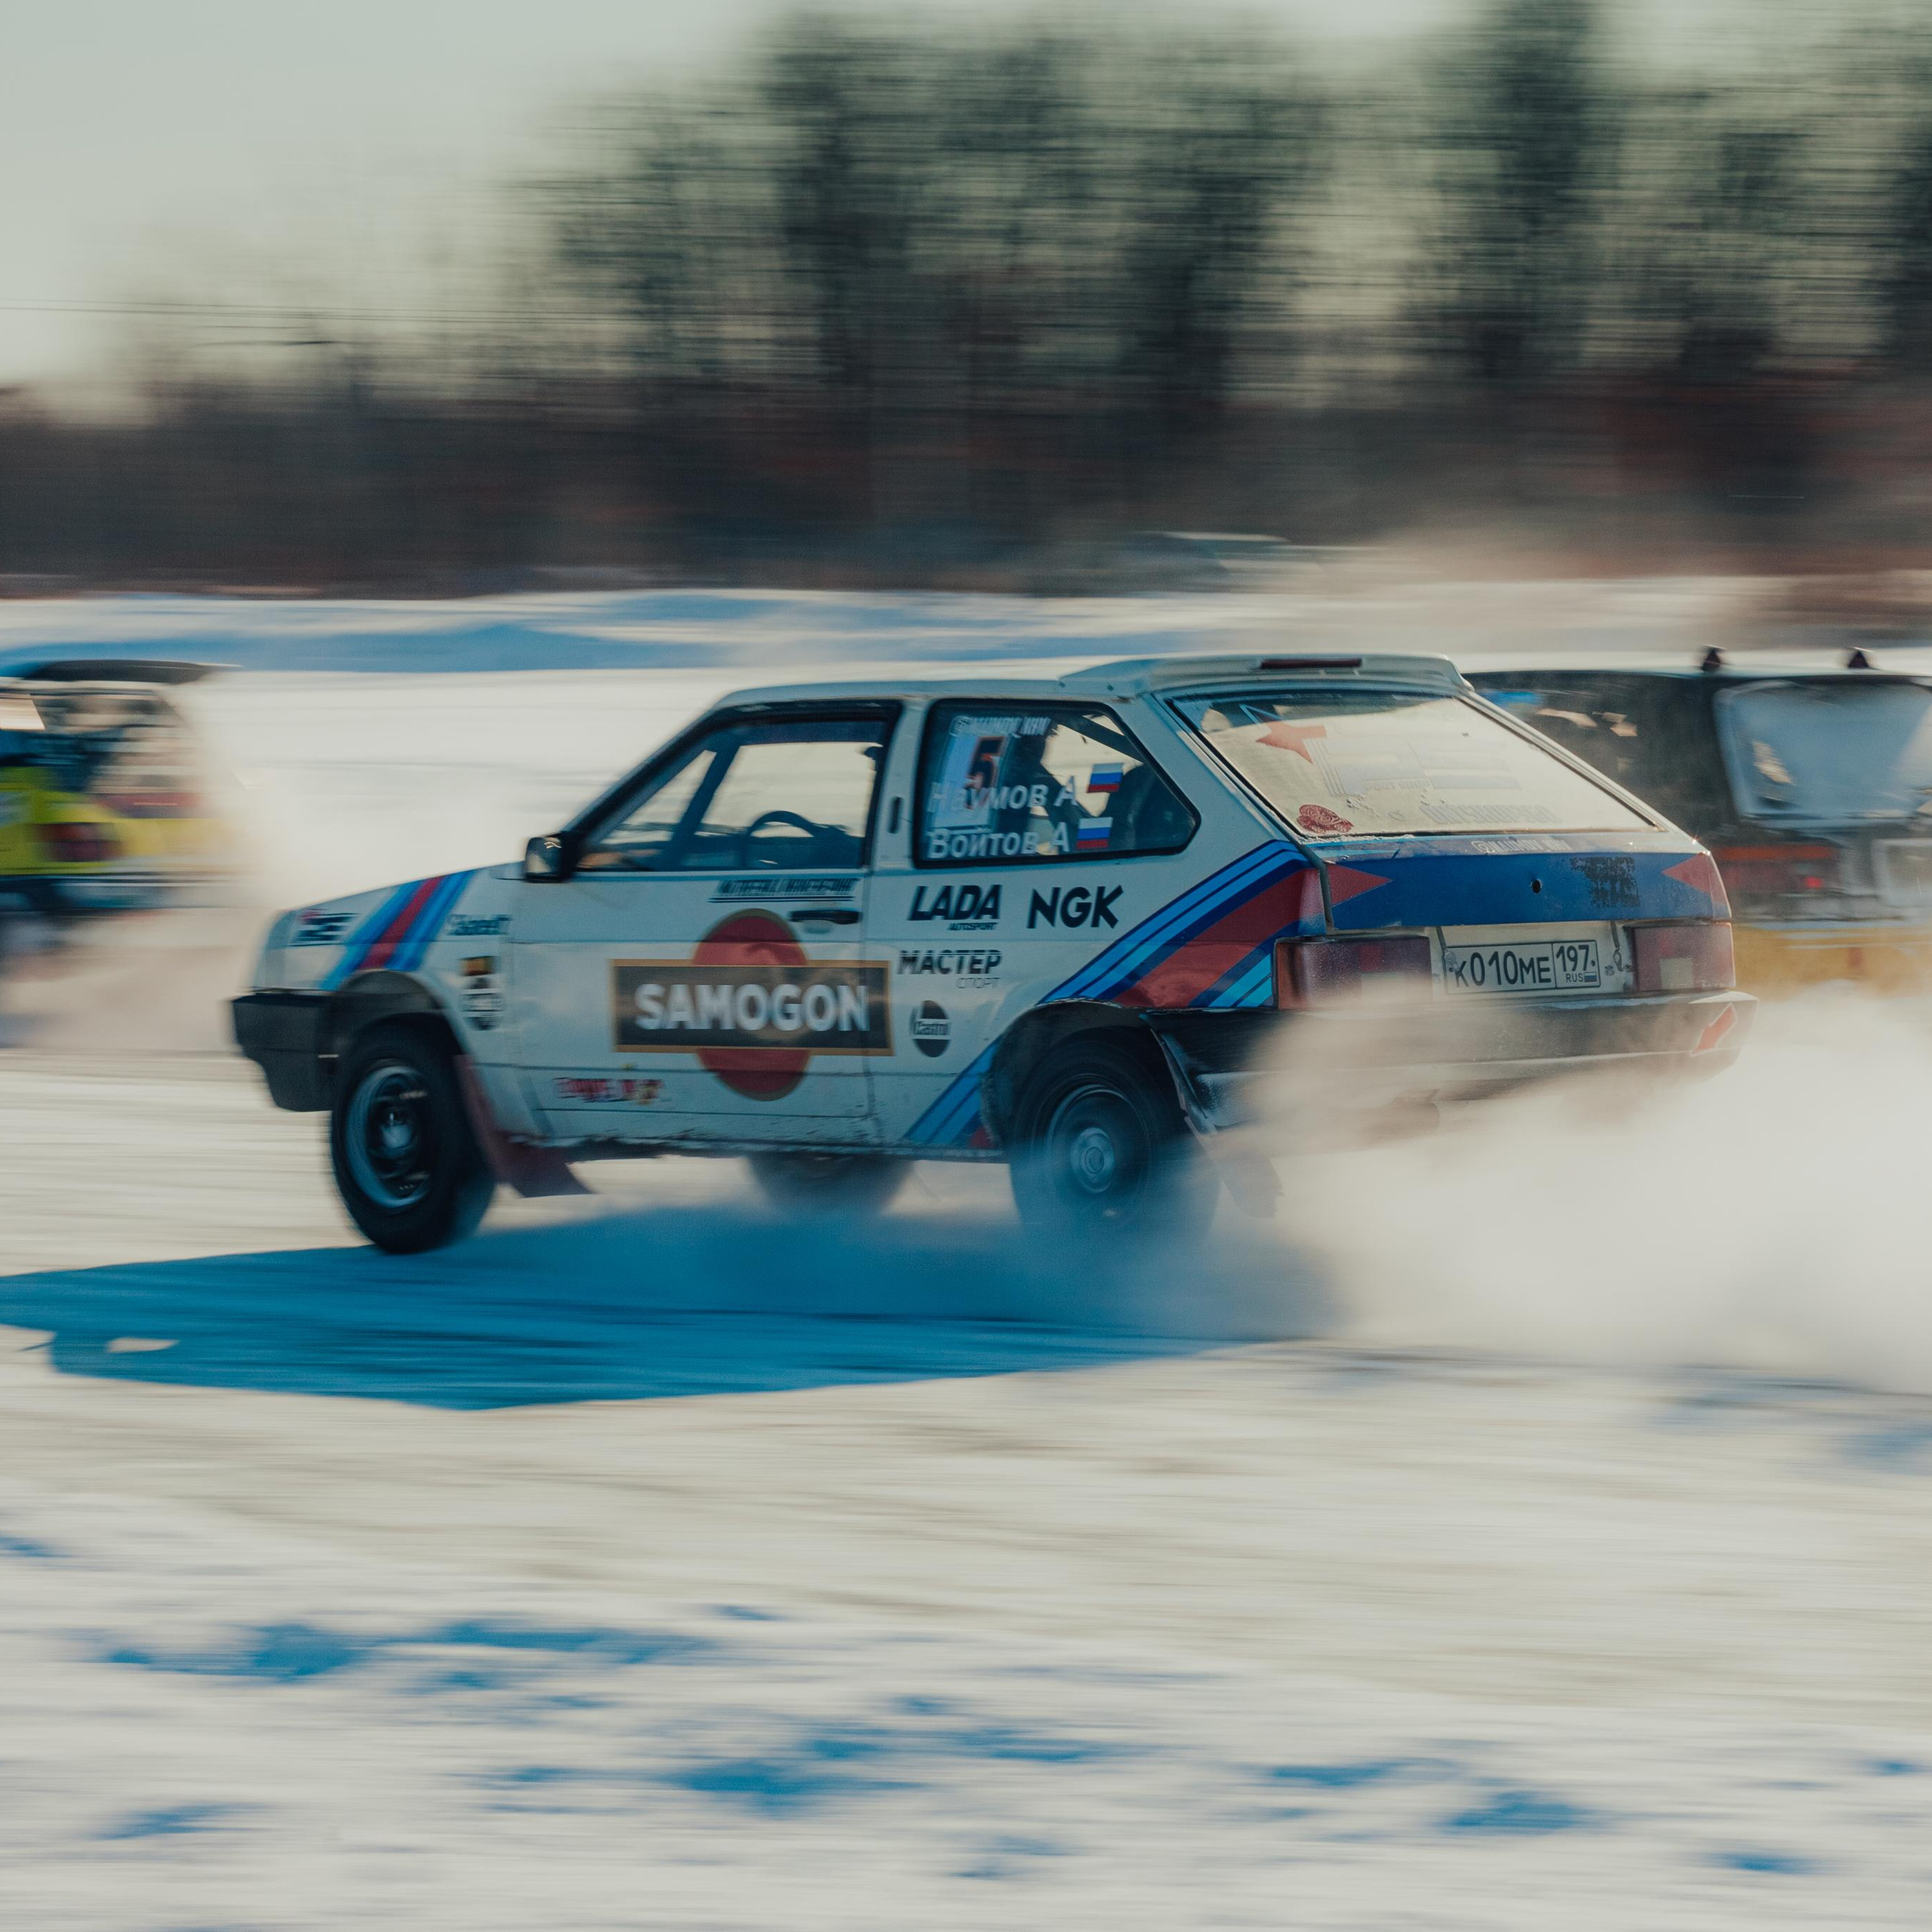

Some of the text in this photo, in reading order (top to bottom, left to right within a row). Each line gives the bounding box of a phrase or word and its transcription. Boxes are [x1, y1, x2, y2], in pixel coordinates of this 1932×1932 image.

[1052, 822, 1070, 853] А
[907, 884, 1003, 921] LADA
[1026, 884, 1124, 929] NGK
[897, 949, 1002, 975] МАСТЕР
[1555, 944, 1591, 972] 197
[1565, 972, 1584, 983] RUS
[634, 983, 870, 1032] SAMOGON
